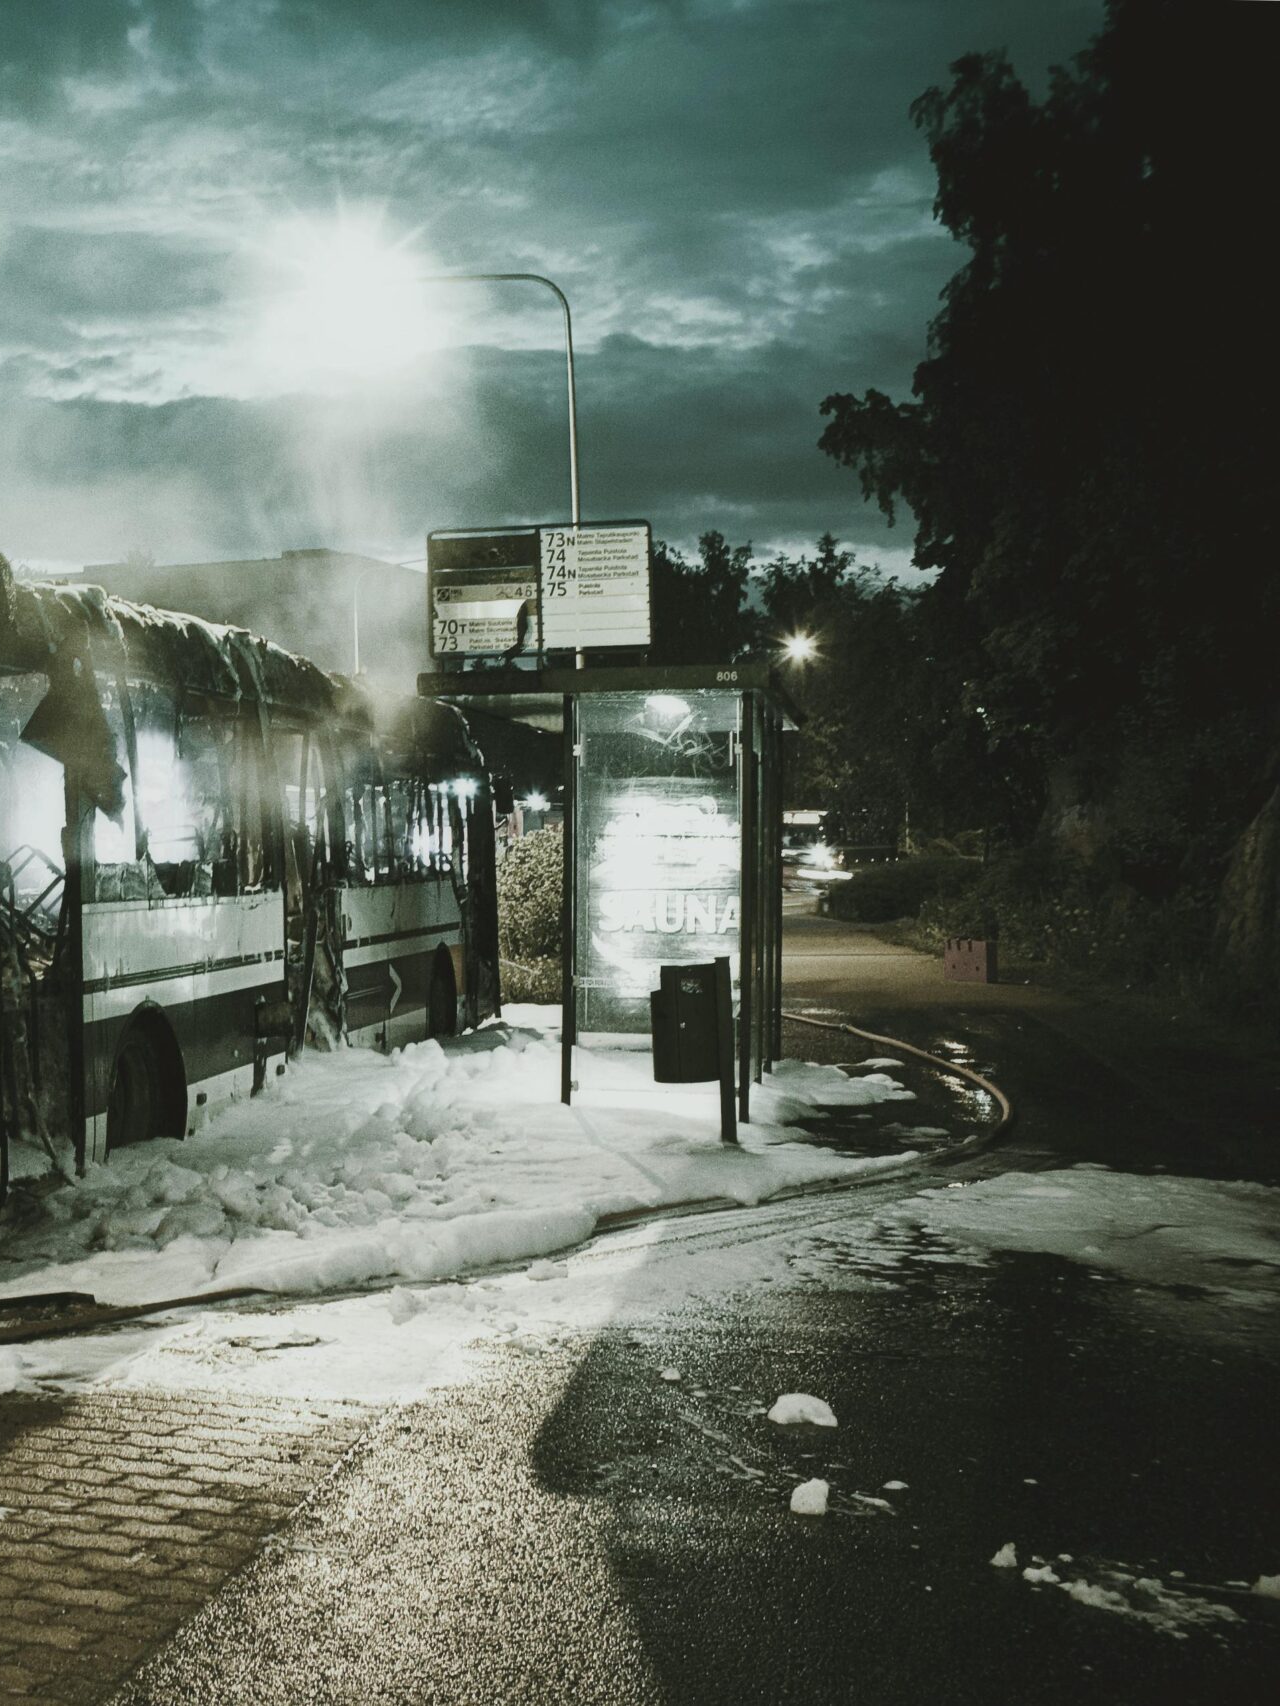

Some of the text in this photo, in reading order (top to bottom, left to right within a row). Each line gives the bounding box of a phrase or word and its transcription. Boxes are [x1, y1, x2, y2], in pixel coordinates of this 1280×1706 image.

[545, 532, 575, 547] 73N
[546, 549, 566, 563] 74
[546, 565, 576, 579] 74N
[547, 582, 567, 596] 75
[438, 619, 467, 634] 70T
[438, 636, 458, 650] 73
[716, 671, 738, 681] 806
[598, 892, 740, 935] SAUNA
